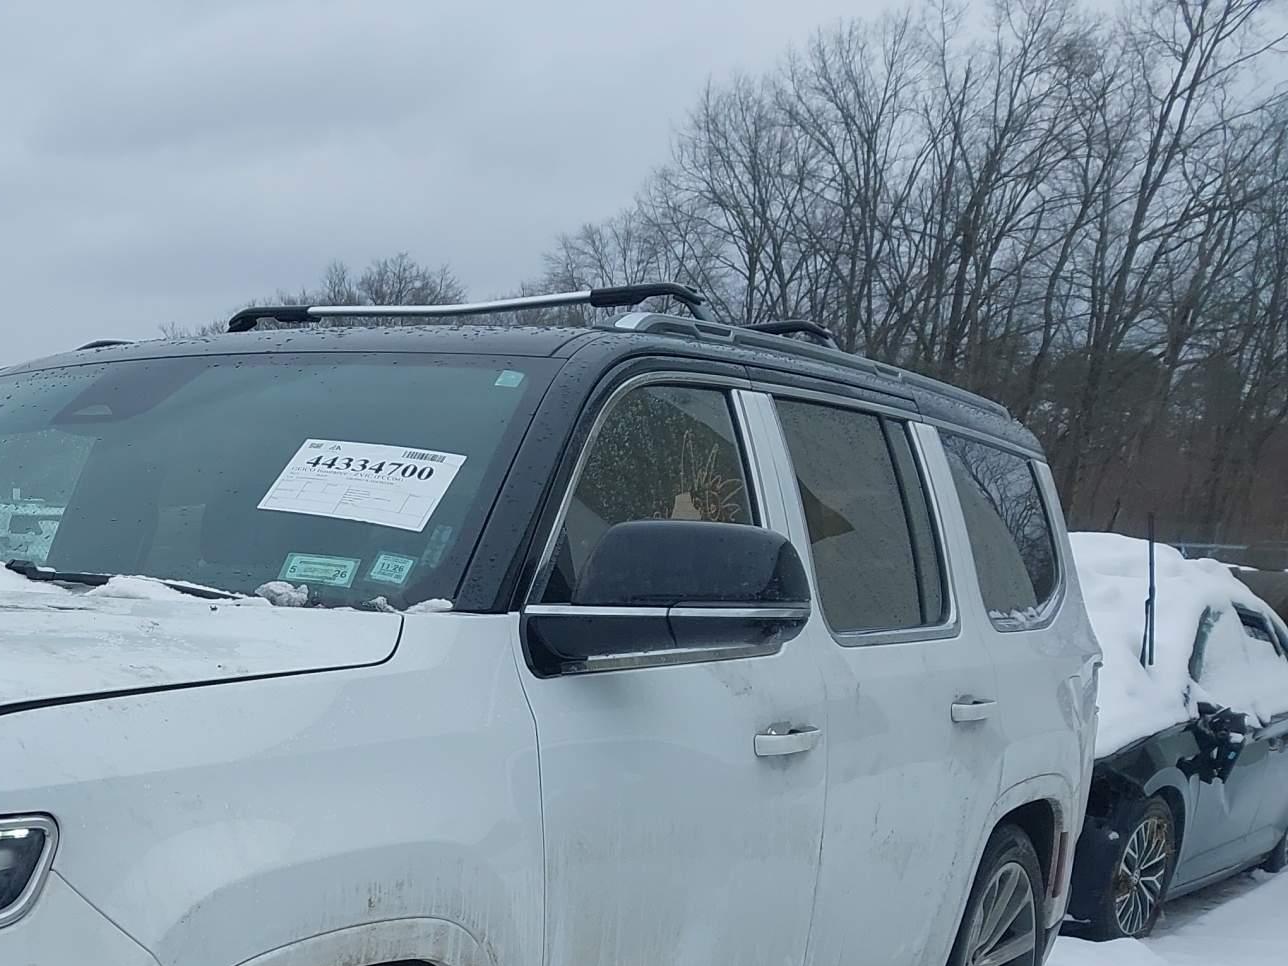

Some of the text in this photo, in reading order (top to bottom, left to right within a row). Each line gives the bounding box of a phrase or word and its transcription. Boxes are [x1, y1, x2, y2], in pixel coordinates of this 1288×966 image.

[306, 455, 434, 481] 44334700
[288, 565, 298, 574] 5
[332, 569, 348, 579] 26
